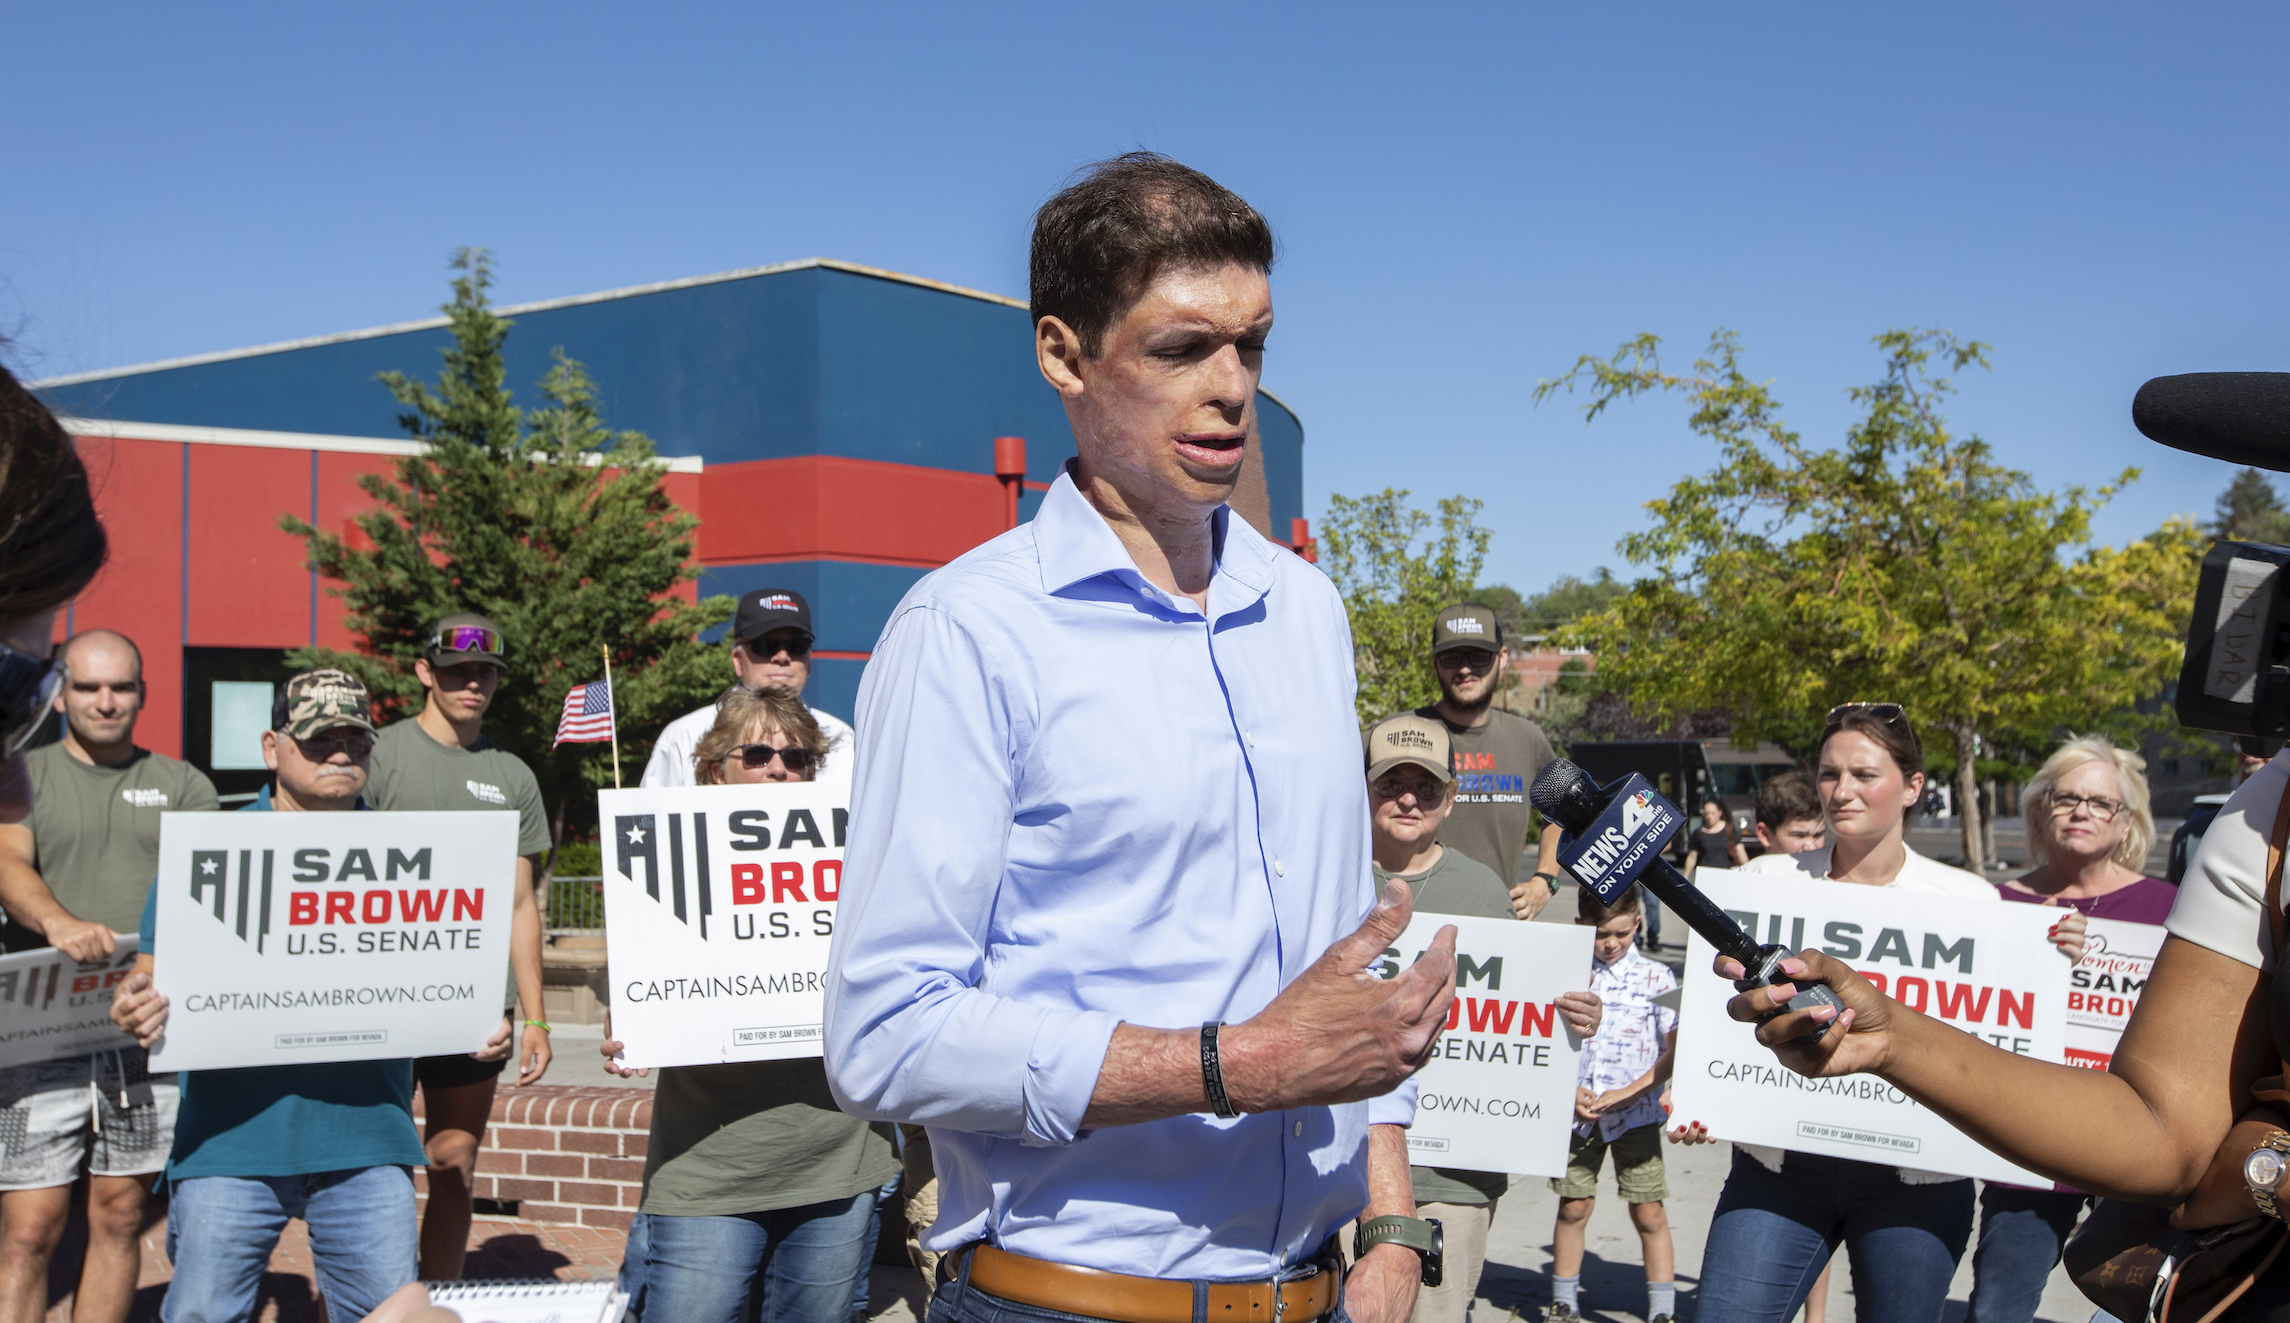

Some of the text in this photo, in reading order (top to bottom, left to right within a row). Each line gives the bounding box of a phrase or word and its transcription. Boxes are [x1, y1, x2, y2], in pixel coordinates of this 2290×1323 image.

[1401, 730, 1425, 738] SAM
[1401, 737, 1433, 747] BROWN
[1454, 752, 1495, 771] SAM
[1454, 794, 1523, 803] OR U.S. SENATE
[728, 808, 849, 851] SA
[1571, 794, 1664, 886] NEWS 4 HD
[292, 848, 432, 883] SAM
[1598, 813, 1673, 895] ON YOUR SIDE
[731, 859, 843, 905] BRO
[289, 888, 484, 926] BROWN
[733, 912, 800, 940] U.S.
[287, 929, 482, 956] U.S. SENATE
[1822, 921, 1975, 974] SAM
[1380, 947, 1503, 991] SM
[2071, 969, 2146, 994] SAM
[186, 984, 475, 1013] CAPTAINSAMBROWN.COM
[2068, 991, 2134, 1017] BRO
[739, 1033, 753, 1041] PAID
[755, 1032, 767, 1040] FOR
[769, 1031, 777, 1039] BY
[779, 1030, 792, 1038] SAM
[794, 1029, 816, 1038] BROWN
[1708, 1060, 1916, 1107] CAPTAINSAMBRO
[1416, 1093, 1540, 1119] OWN.COM
[1424, 1140, 1444, 1149] NEVADA
[1802, 1125, 1914, 1149] PAID FOR BY SAM BROWN FOR NEVADA
